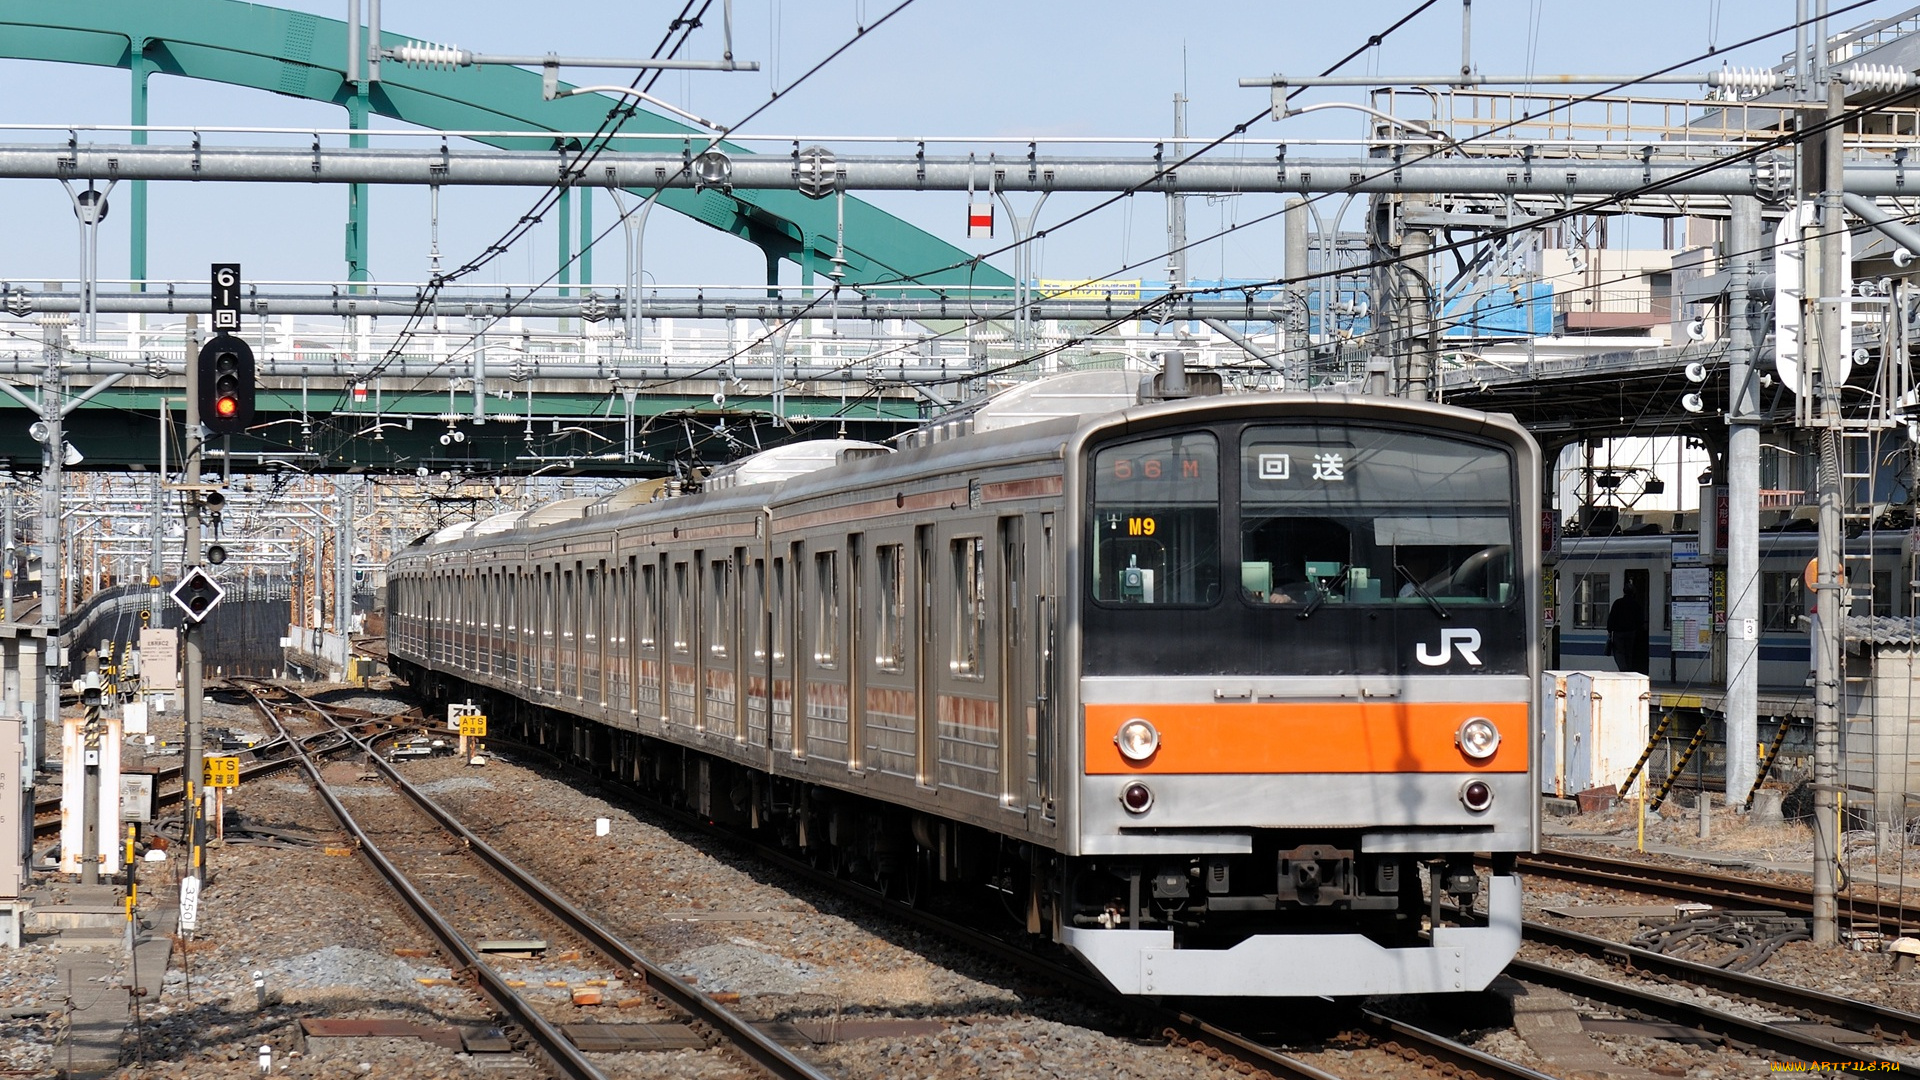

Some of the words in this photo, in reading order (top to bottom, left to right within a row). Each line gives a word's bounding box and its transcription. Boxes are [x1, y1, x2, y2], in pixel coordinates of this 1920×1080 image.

[1258, 453, 1345, 481] 回送
[1128, 517, 1156, 536] M9
[1747, 625, 1753, 634] 3
[1416, 628, 1483, 666] JR
[462, 717, 484, 725] ATS
[203, 760, 235, 771] ATS
[203, 773, 235, 785] P確認
[183, 887, 196, 920] 3750
